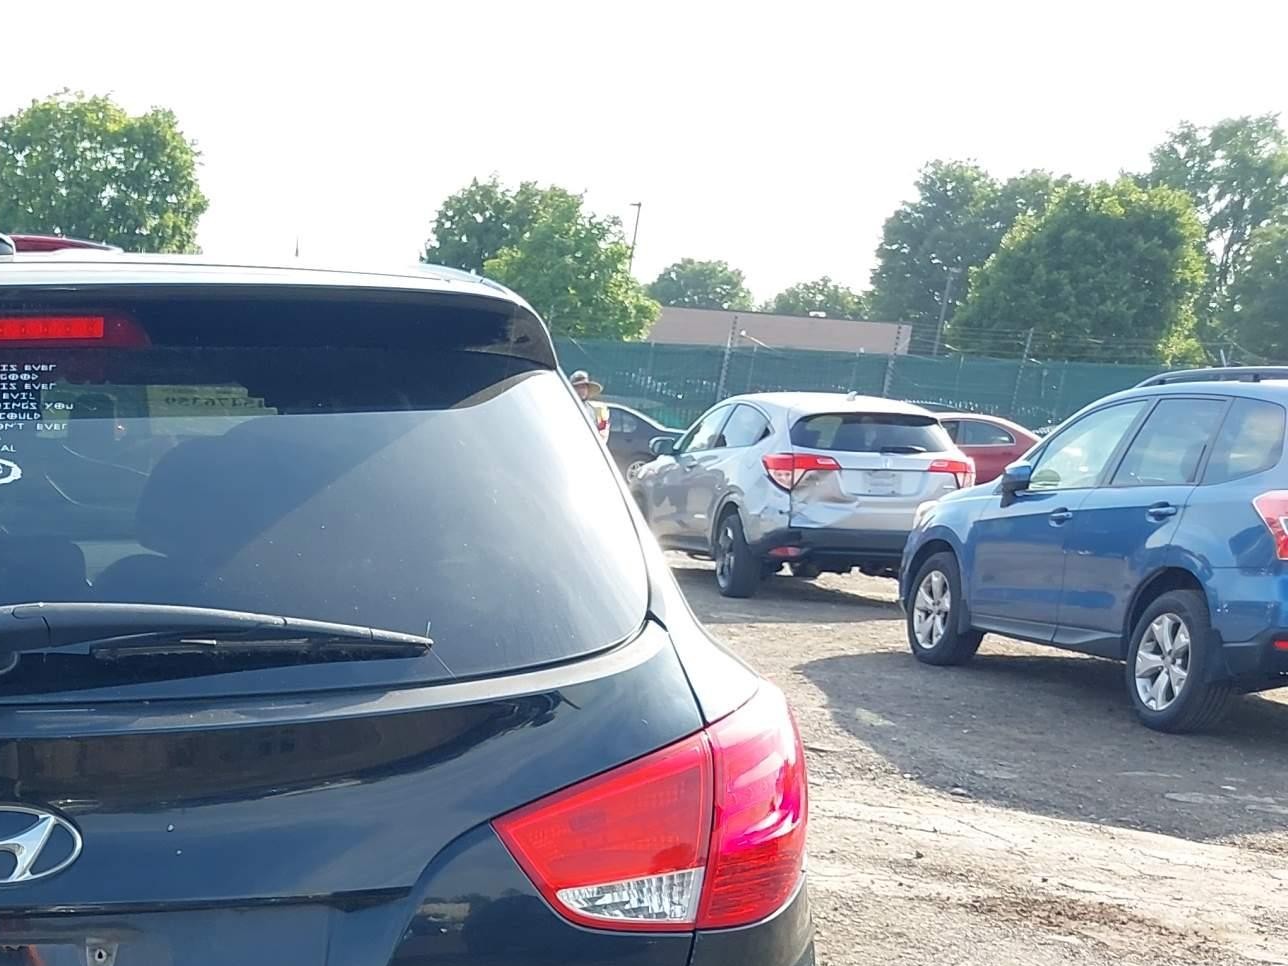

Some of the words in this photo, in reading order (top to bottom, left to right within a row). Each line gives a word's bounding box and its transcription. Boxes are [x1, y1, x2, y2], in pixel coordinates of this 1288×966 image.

[0, 364, 18, 372] IS
[24, 364, 56, 372] EVER
[0, 373, 39, 381] GOOD
[0, 382, 17, 390] IS
[24, 382, 56, 390] EVER
[2, 392, 35, 400] EVIL
[44, 402, 74, 410] YOU
